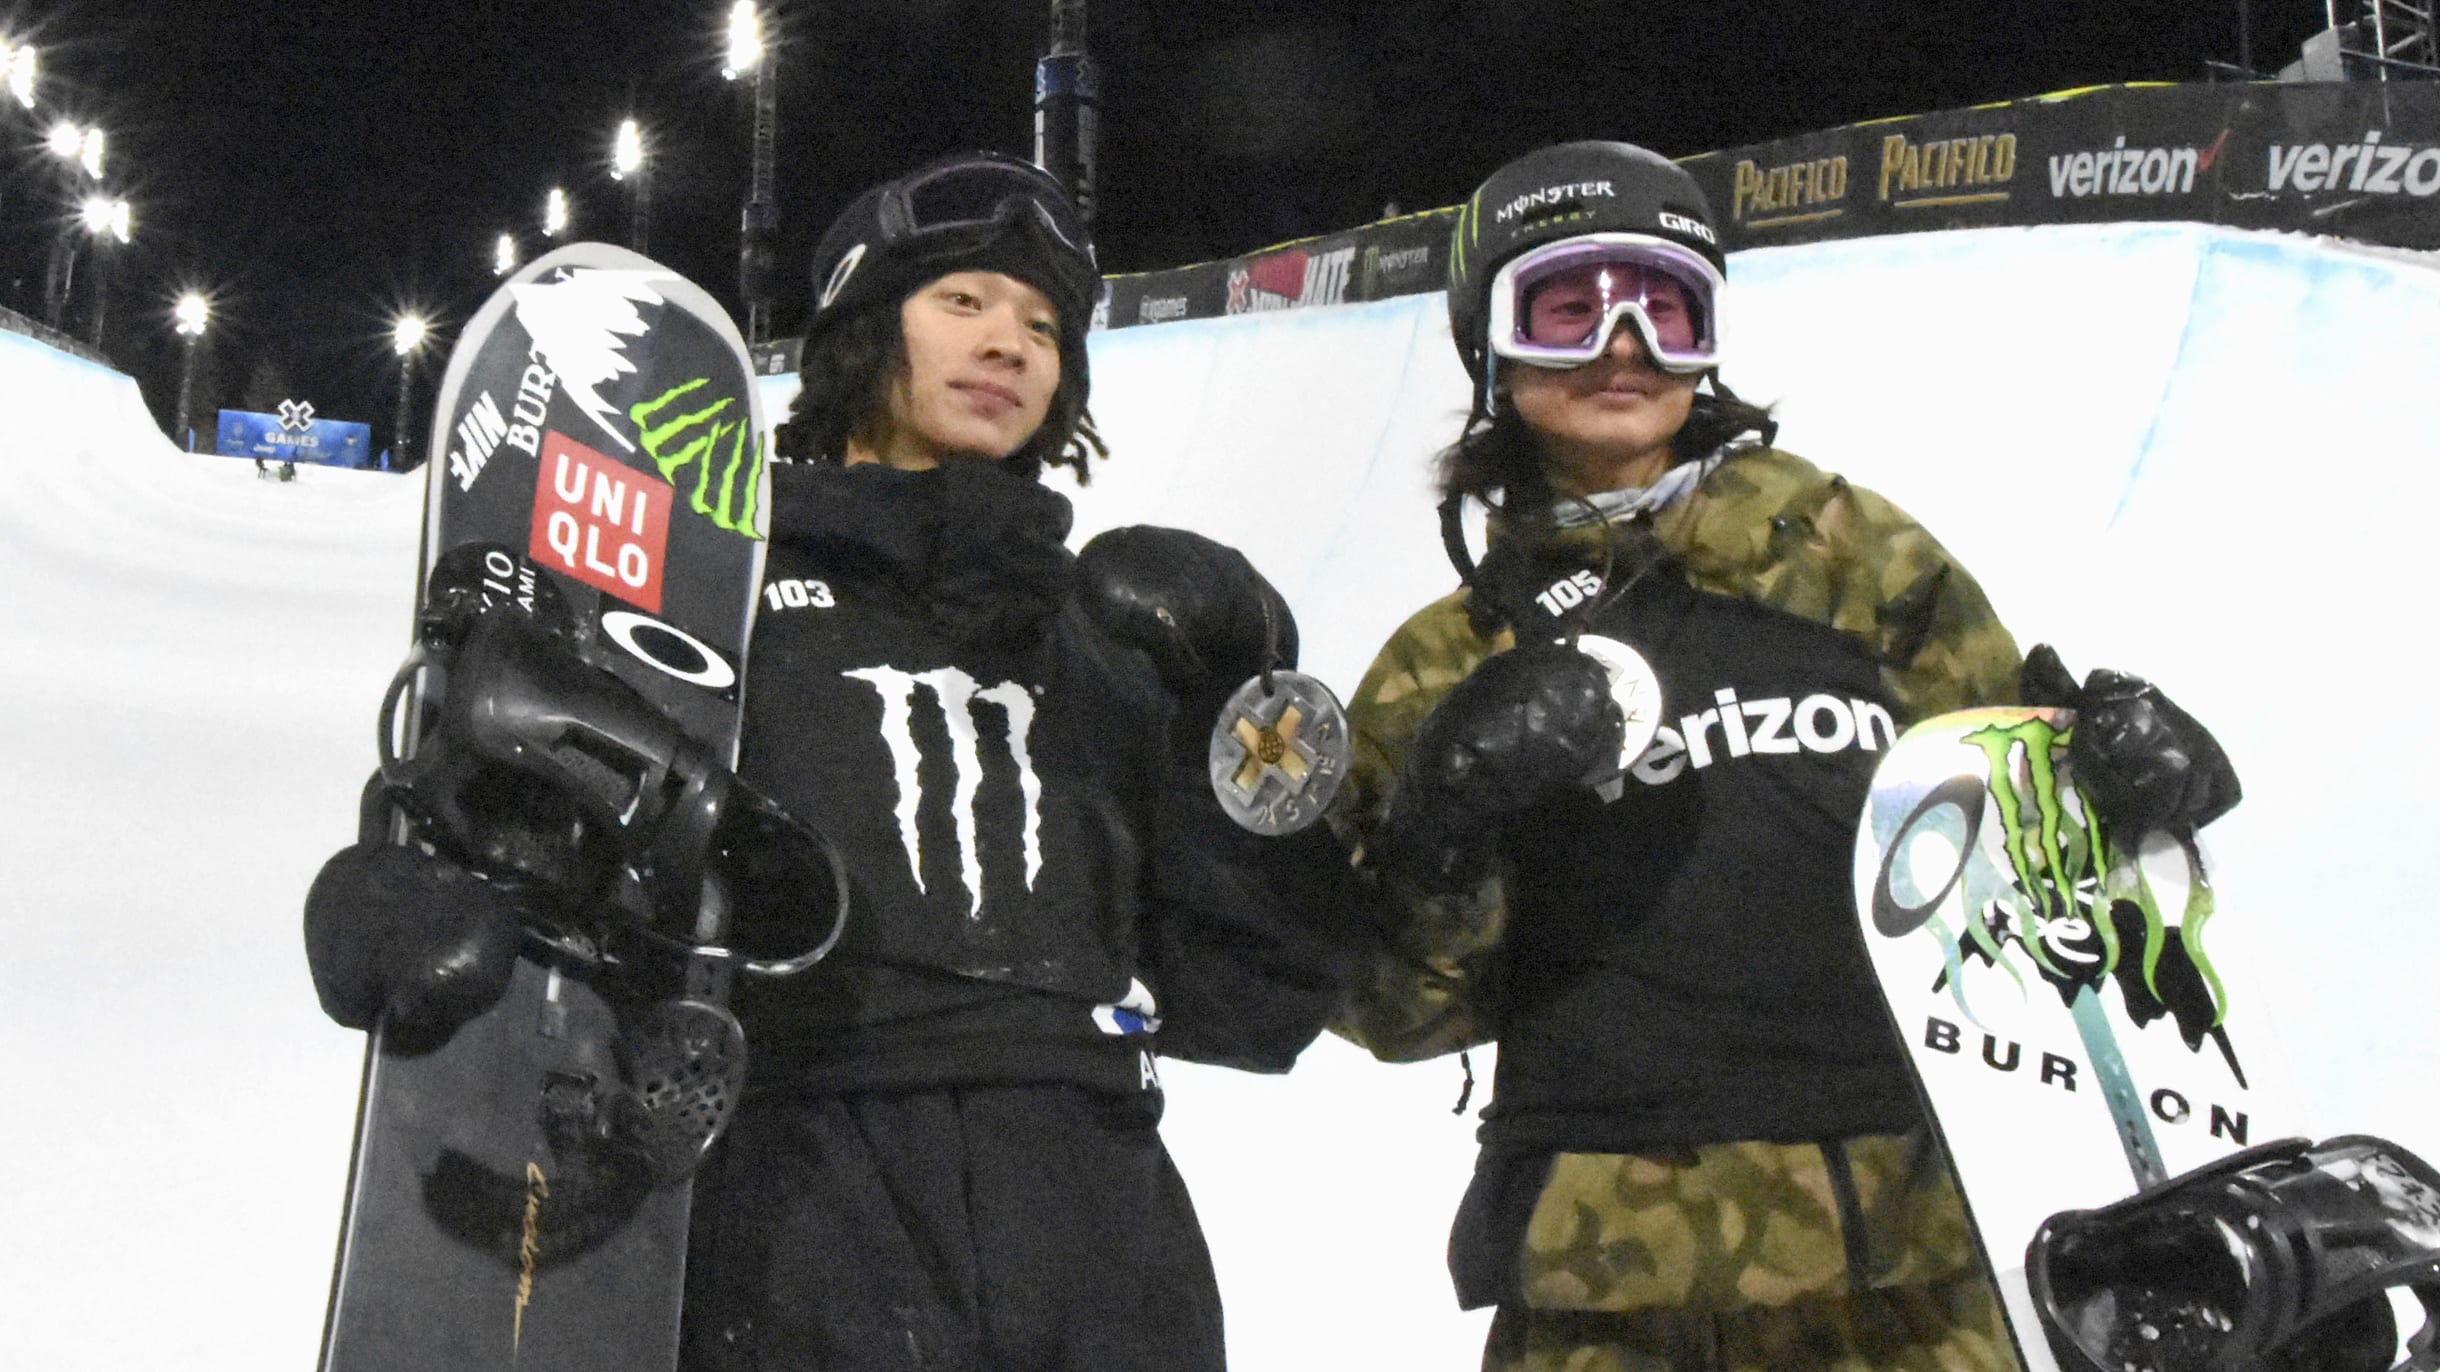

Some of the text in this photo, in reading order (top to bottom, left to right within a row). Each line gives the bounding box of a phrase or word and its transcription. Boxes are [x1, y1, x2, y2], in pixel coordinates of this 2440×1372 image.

[1733, 156, 1847, 220] PACIFICO
[1880, 133, 2016, 201] PACIFICO
[2049, 135, 2197, 197] verizon
[1659, 212, 1715, 244] GIRO
[264, 432, 319, 447] GAMES
[554, 453, 647, 536] UNI
[547, 511, 648, 588] QLO
[764, 580, 835, 611] 103
[1536, 570, 1602, 617] 105
[1596, 688, 1897, 803] erizon
